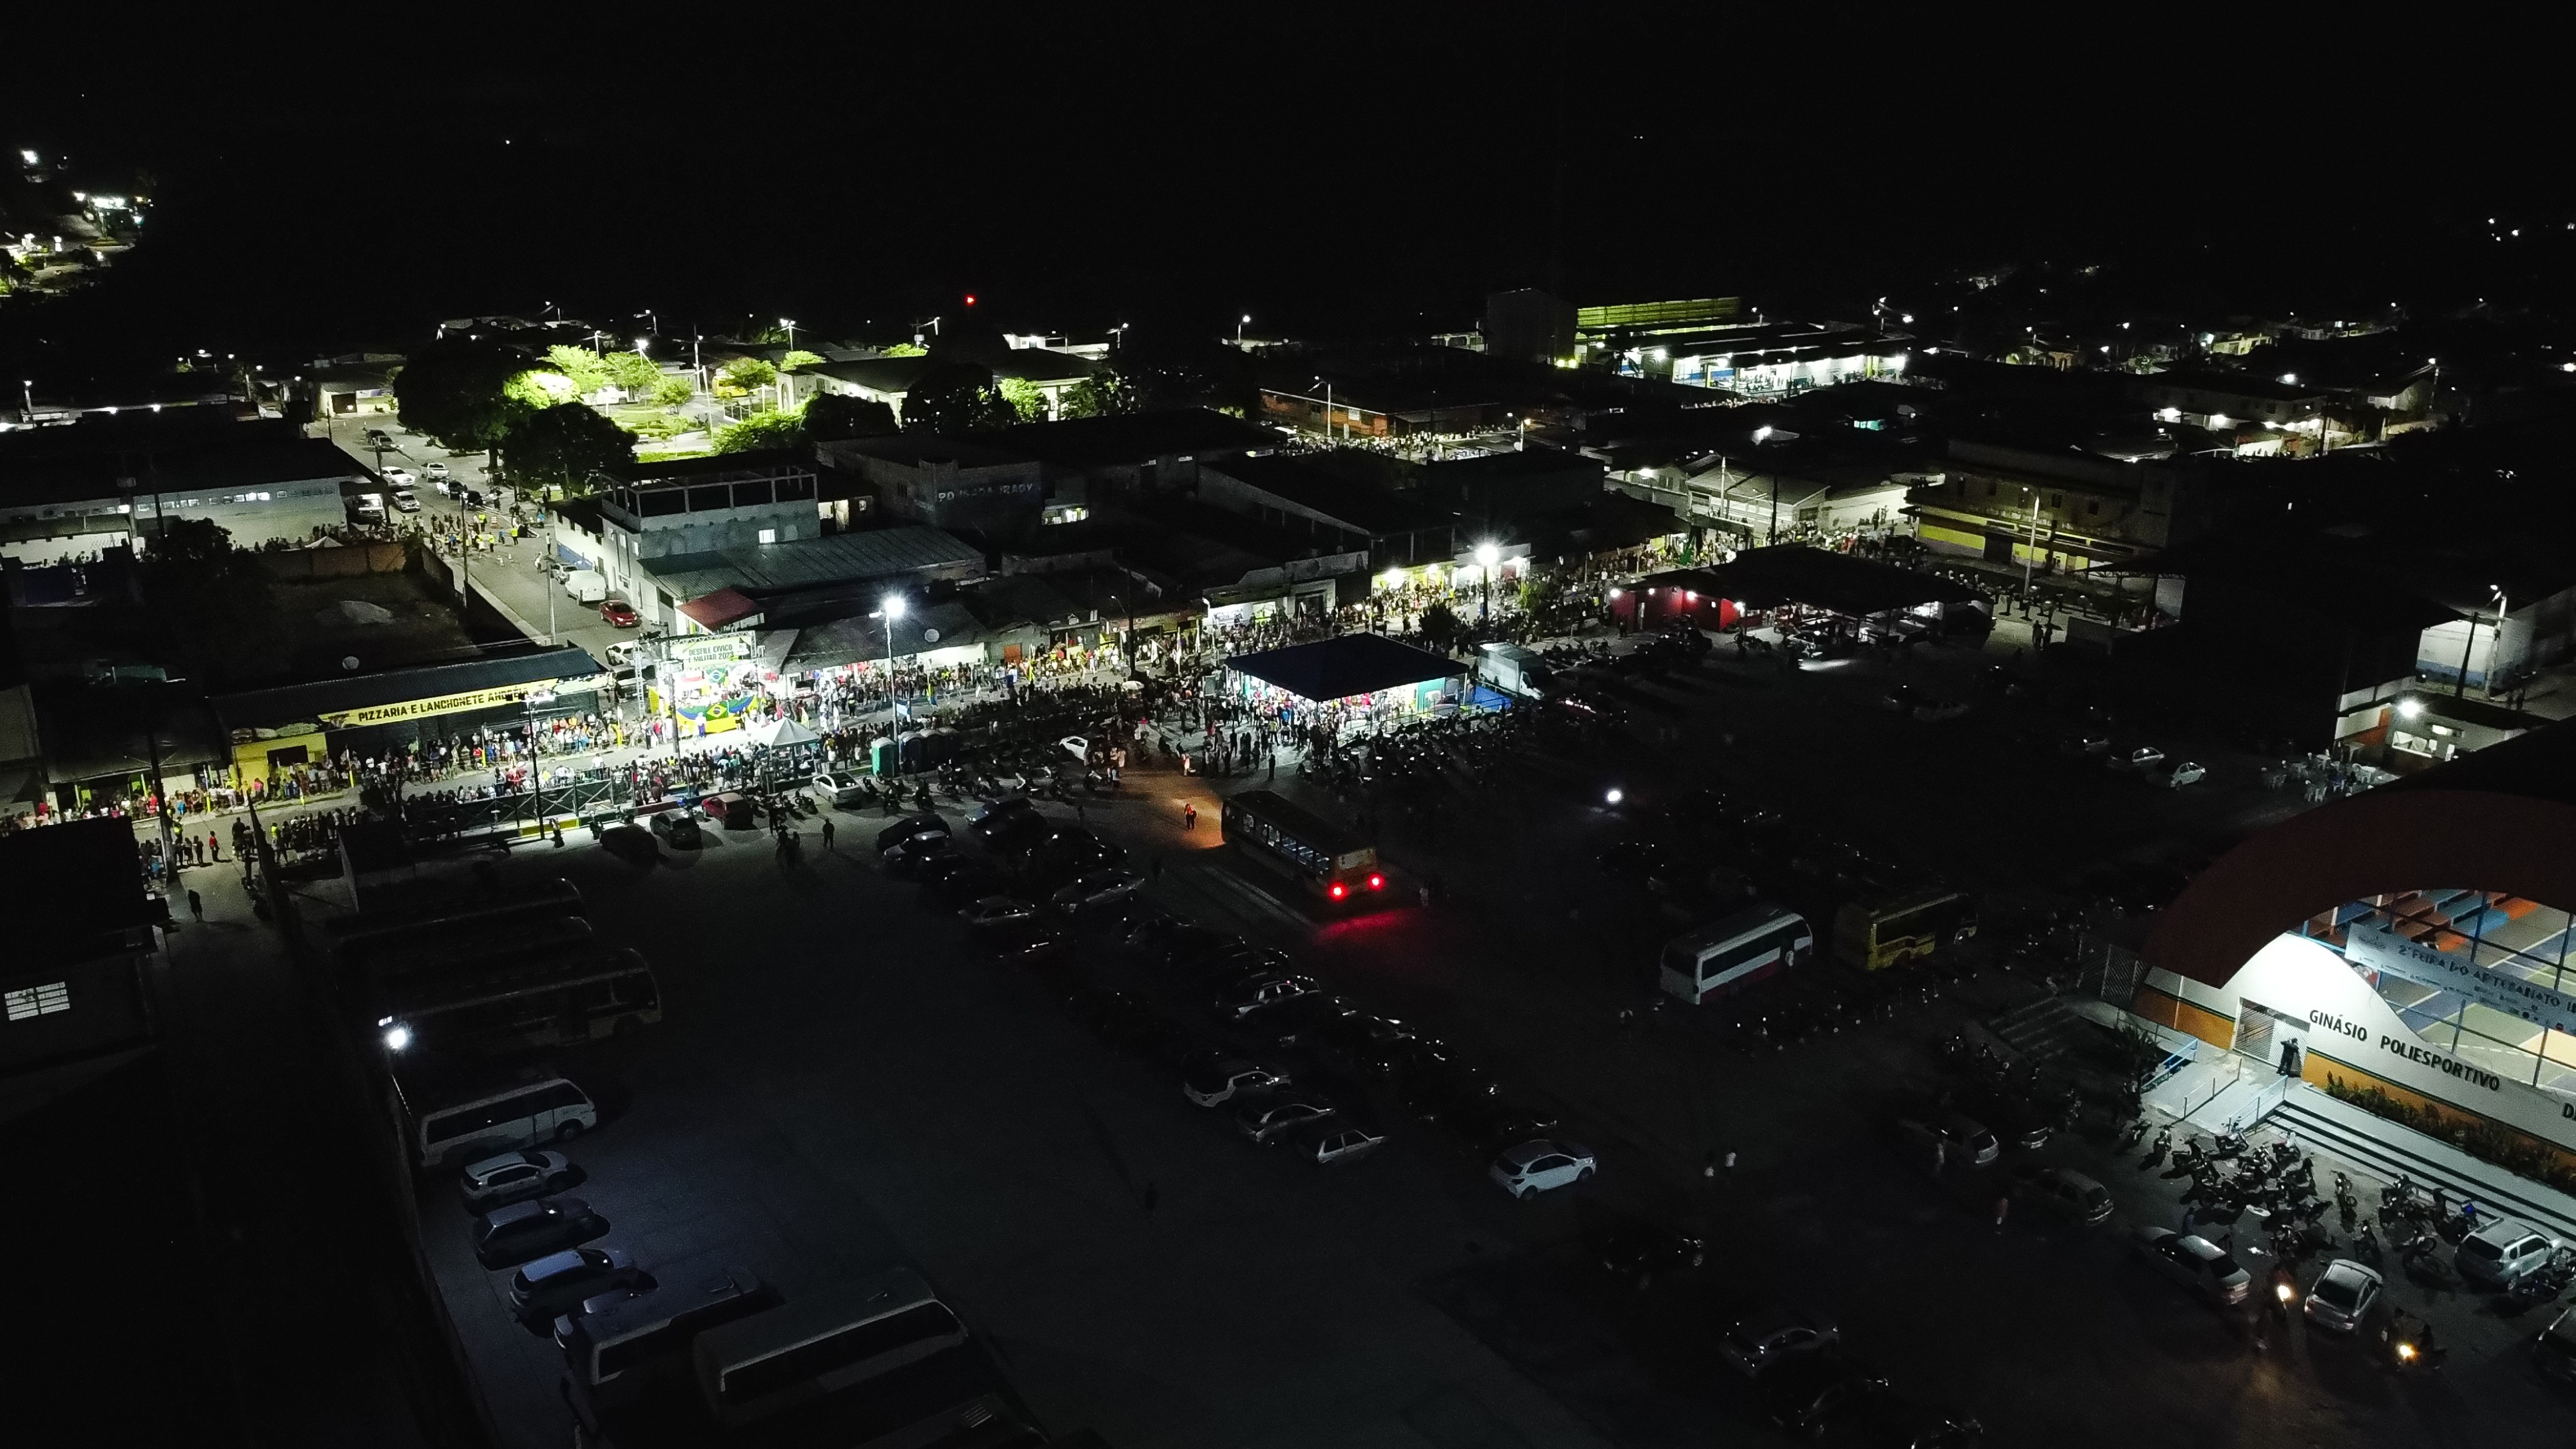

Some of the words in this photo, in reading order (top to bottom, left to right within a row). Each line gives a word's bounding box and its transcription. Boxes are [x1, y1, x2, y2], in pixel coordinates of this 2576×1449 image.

[359, 707, 407, 722] PIZZARIA
[411, 704, 417, 714] E
[420, 694, 484, 713] LANCHONETE
[2412, 949, 2446, 969] FEIRA
[2449, 960, 2469, 976] DO
[2309, 1009, 2368, 1042] GINÁSIO
[2380, 1035, 2500, 1091] POLIESPORTIVO
[2563, 1102, 2576, 1122] D
